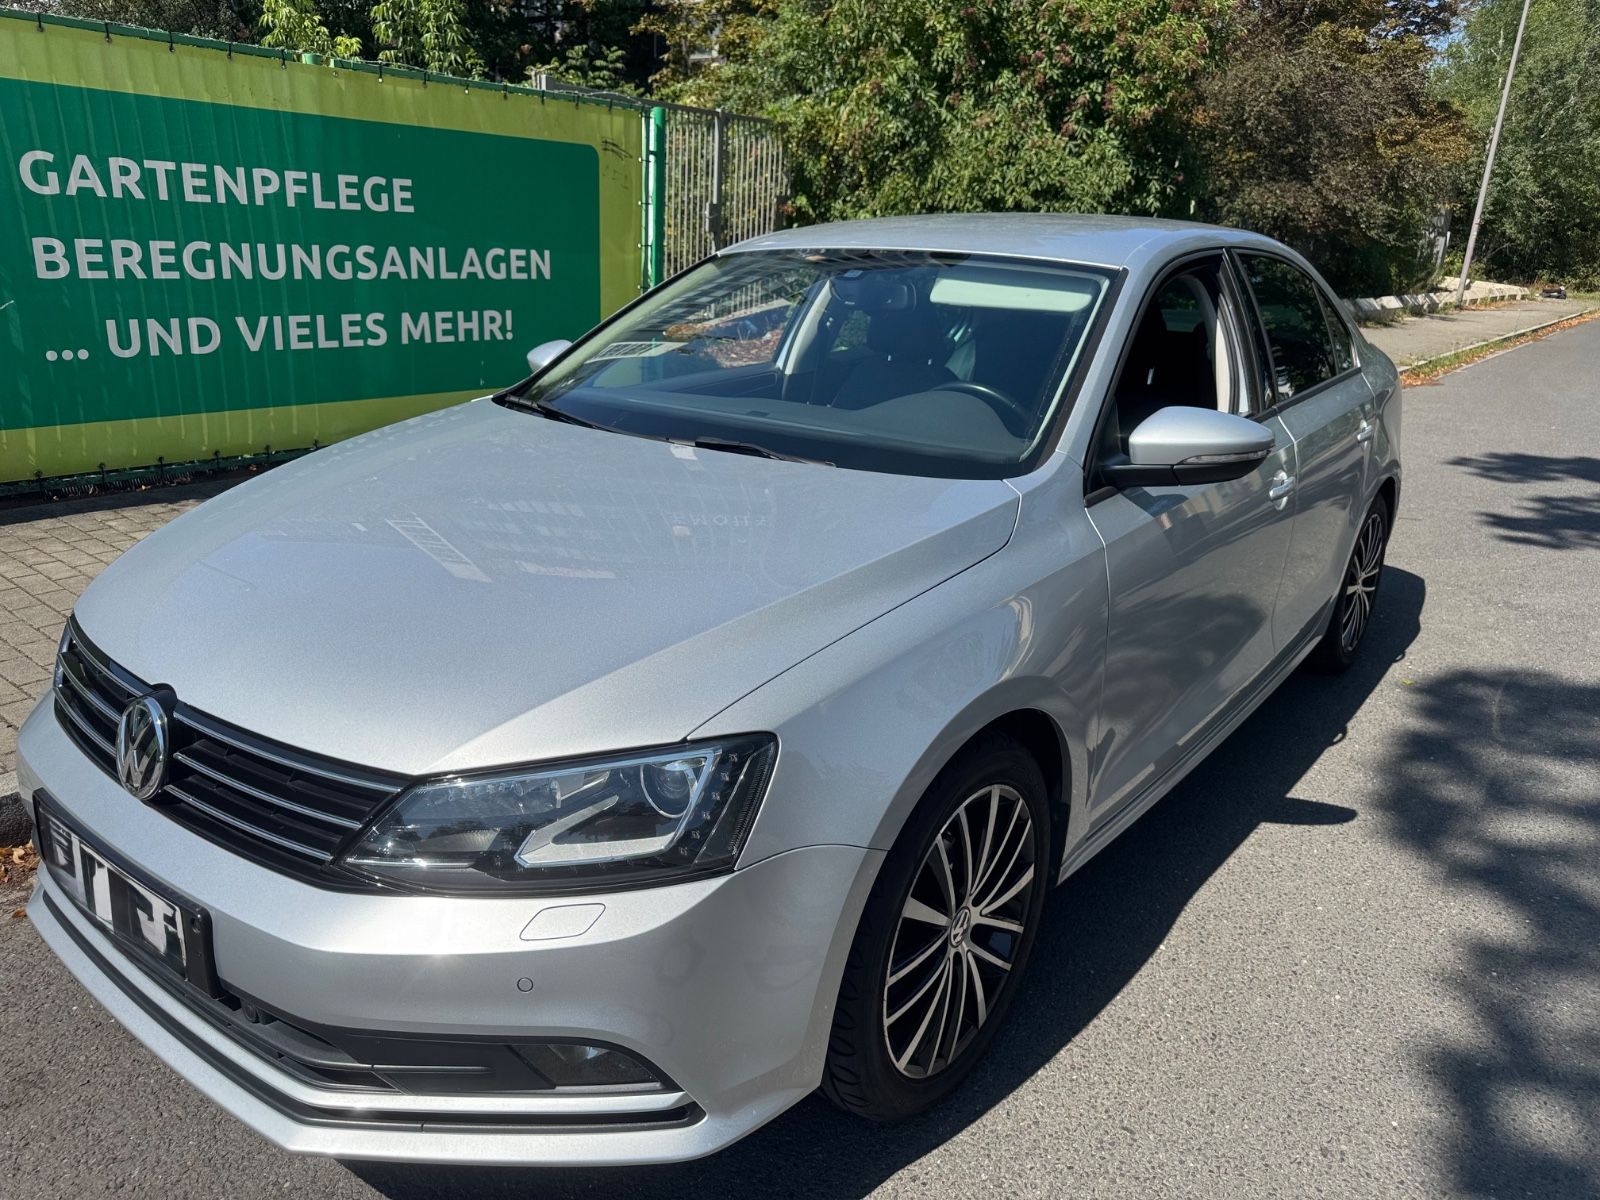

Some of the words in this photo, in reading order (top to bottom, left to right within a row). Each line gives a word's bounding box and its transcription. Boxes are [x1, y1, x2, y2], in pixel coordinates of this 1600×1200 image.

[19, 150, 415, 213] GARTENPFLEGE
[32, 237, 551, 280] BEREGNUNGSANLAGEN
[106, 317, 221, 358] UND
[235, 312, 388, 352] VIELES
[401, 309, 514, 344] MEHR!
[117, 697, 168, 799] VW
